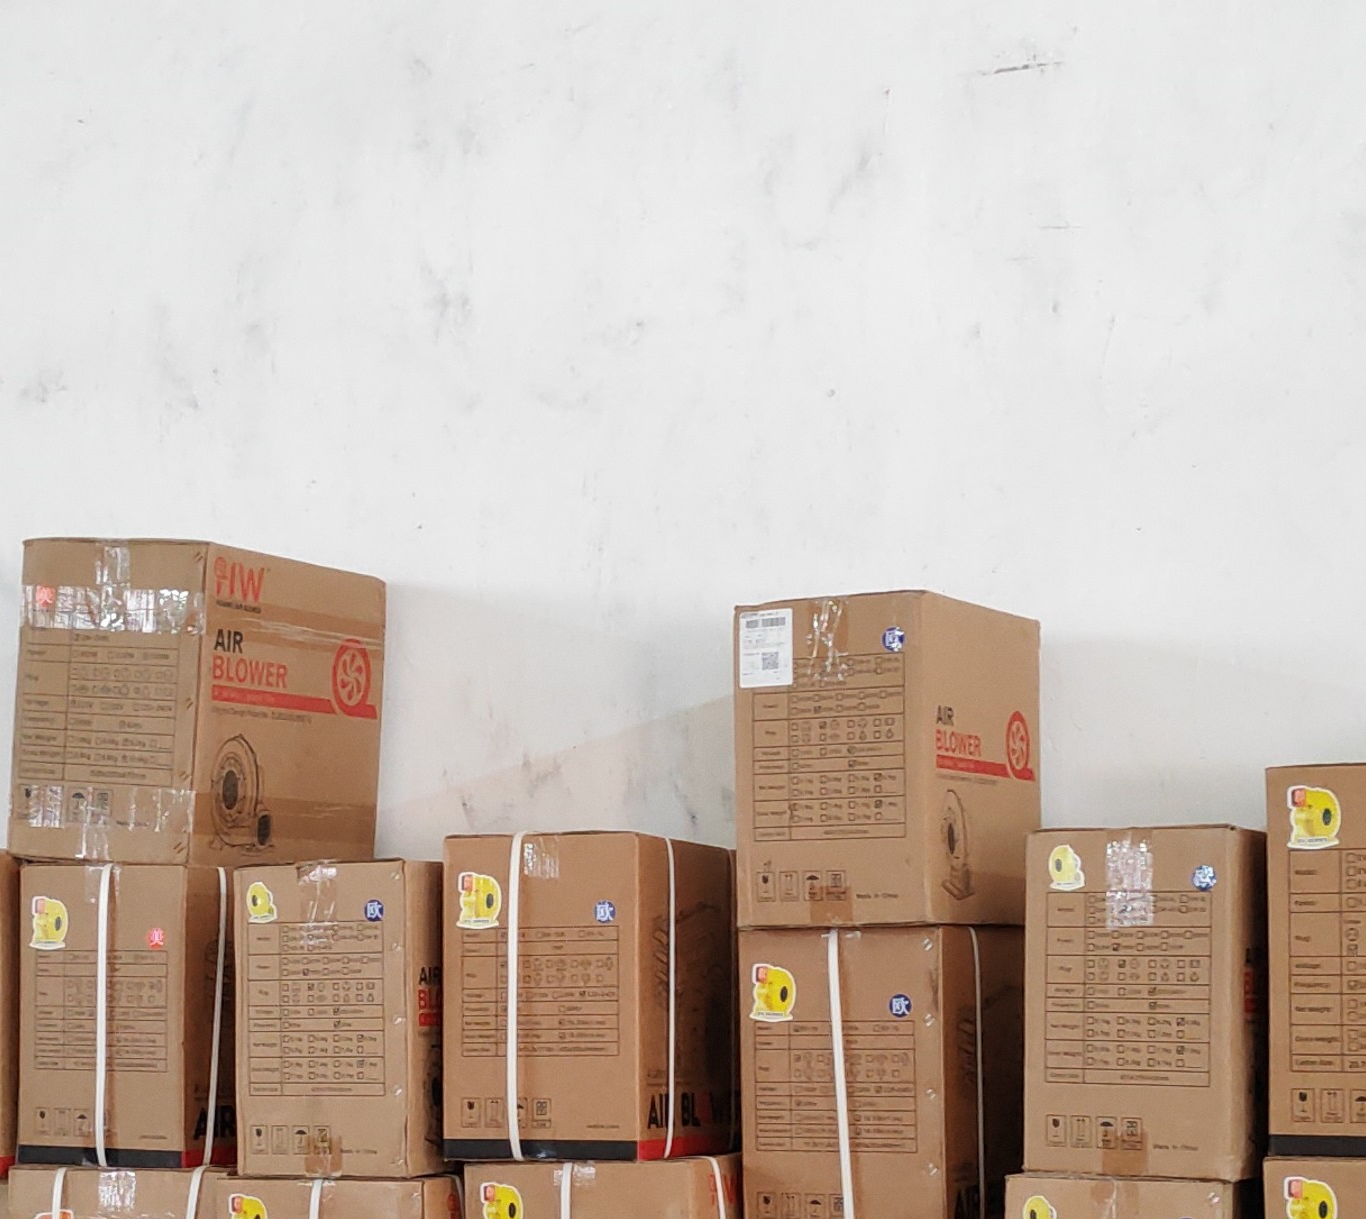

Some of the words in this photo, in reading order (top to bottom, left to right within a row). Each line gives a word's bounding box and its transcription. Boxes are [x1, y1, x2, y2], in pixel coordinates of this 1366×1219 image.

[214, 628, 244, 654] AIR
[212, 654, 288, 689] BLOWER
[936, 705, 955, 727] AIR
[935, 728, 983, 757] BLOWER
[366, 903, 383, 919] 欧
[596, 902, 614, 921] 欧
[892, 997, 910, 1015] 欧
